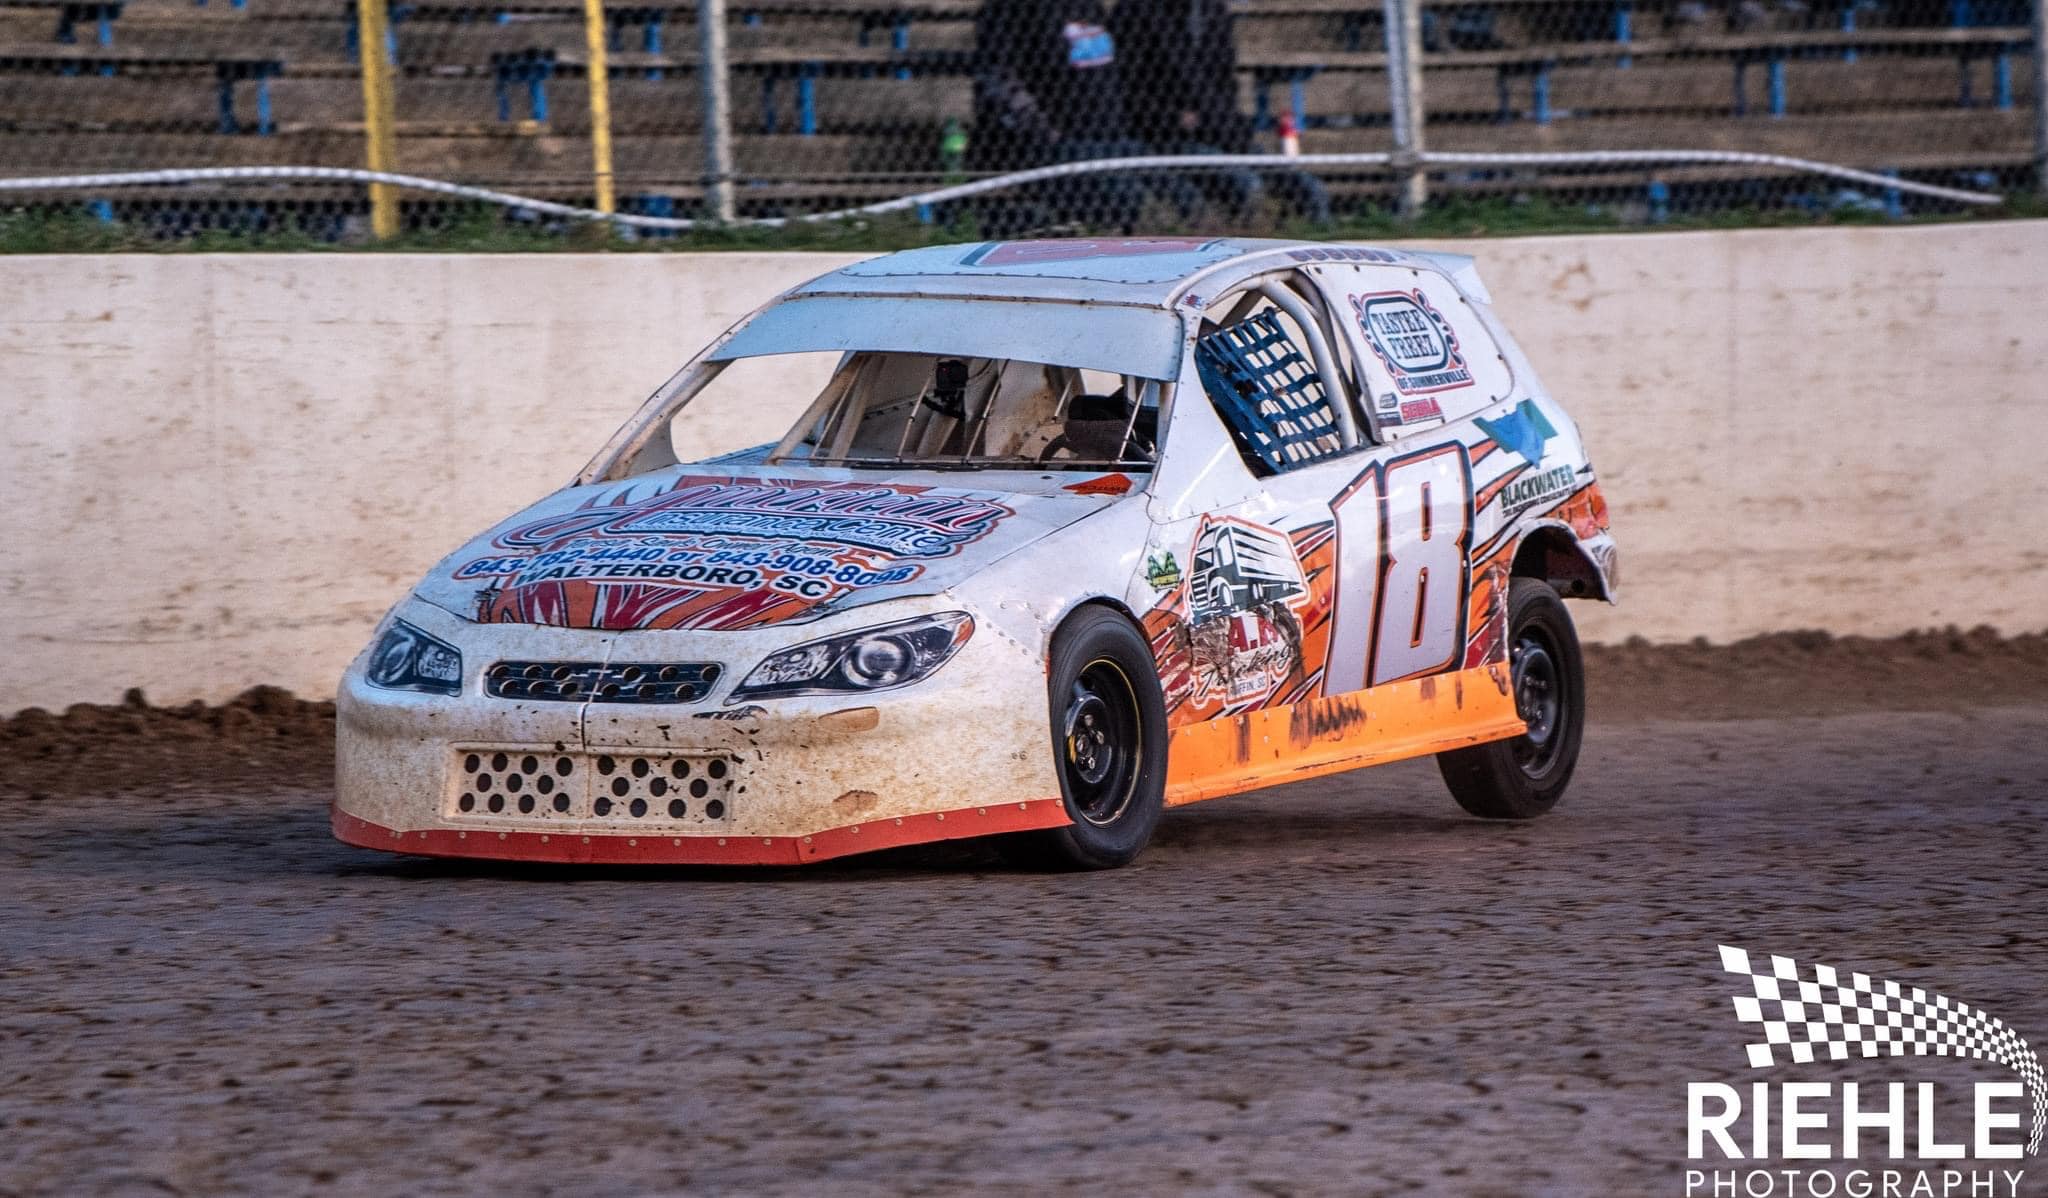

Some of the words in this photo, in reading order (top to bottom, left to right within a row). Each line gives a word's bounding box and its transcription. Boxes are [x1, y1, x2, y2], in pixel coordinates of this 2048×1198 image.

[1371, 309, 1428, 335] TASTEE
[1387, 334, 1440, 360] FREEZ
[1500, 464, 1576, 508] BLACKWATER
[667, 553, 702, 563] or
[1320, 439, 1474, 699] 18
[774, 574, 828, 597] SC
